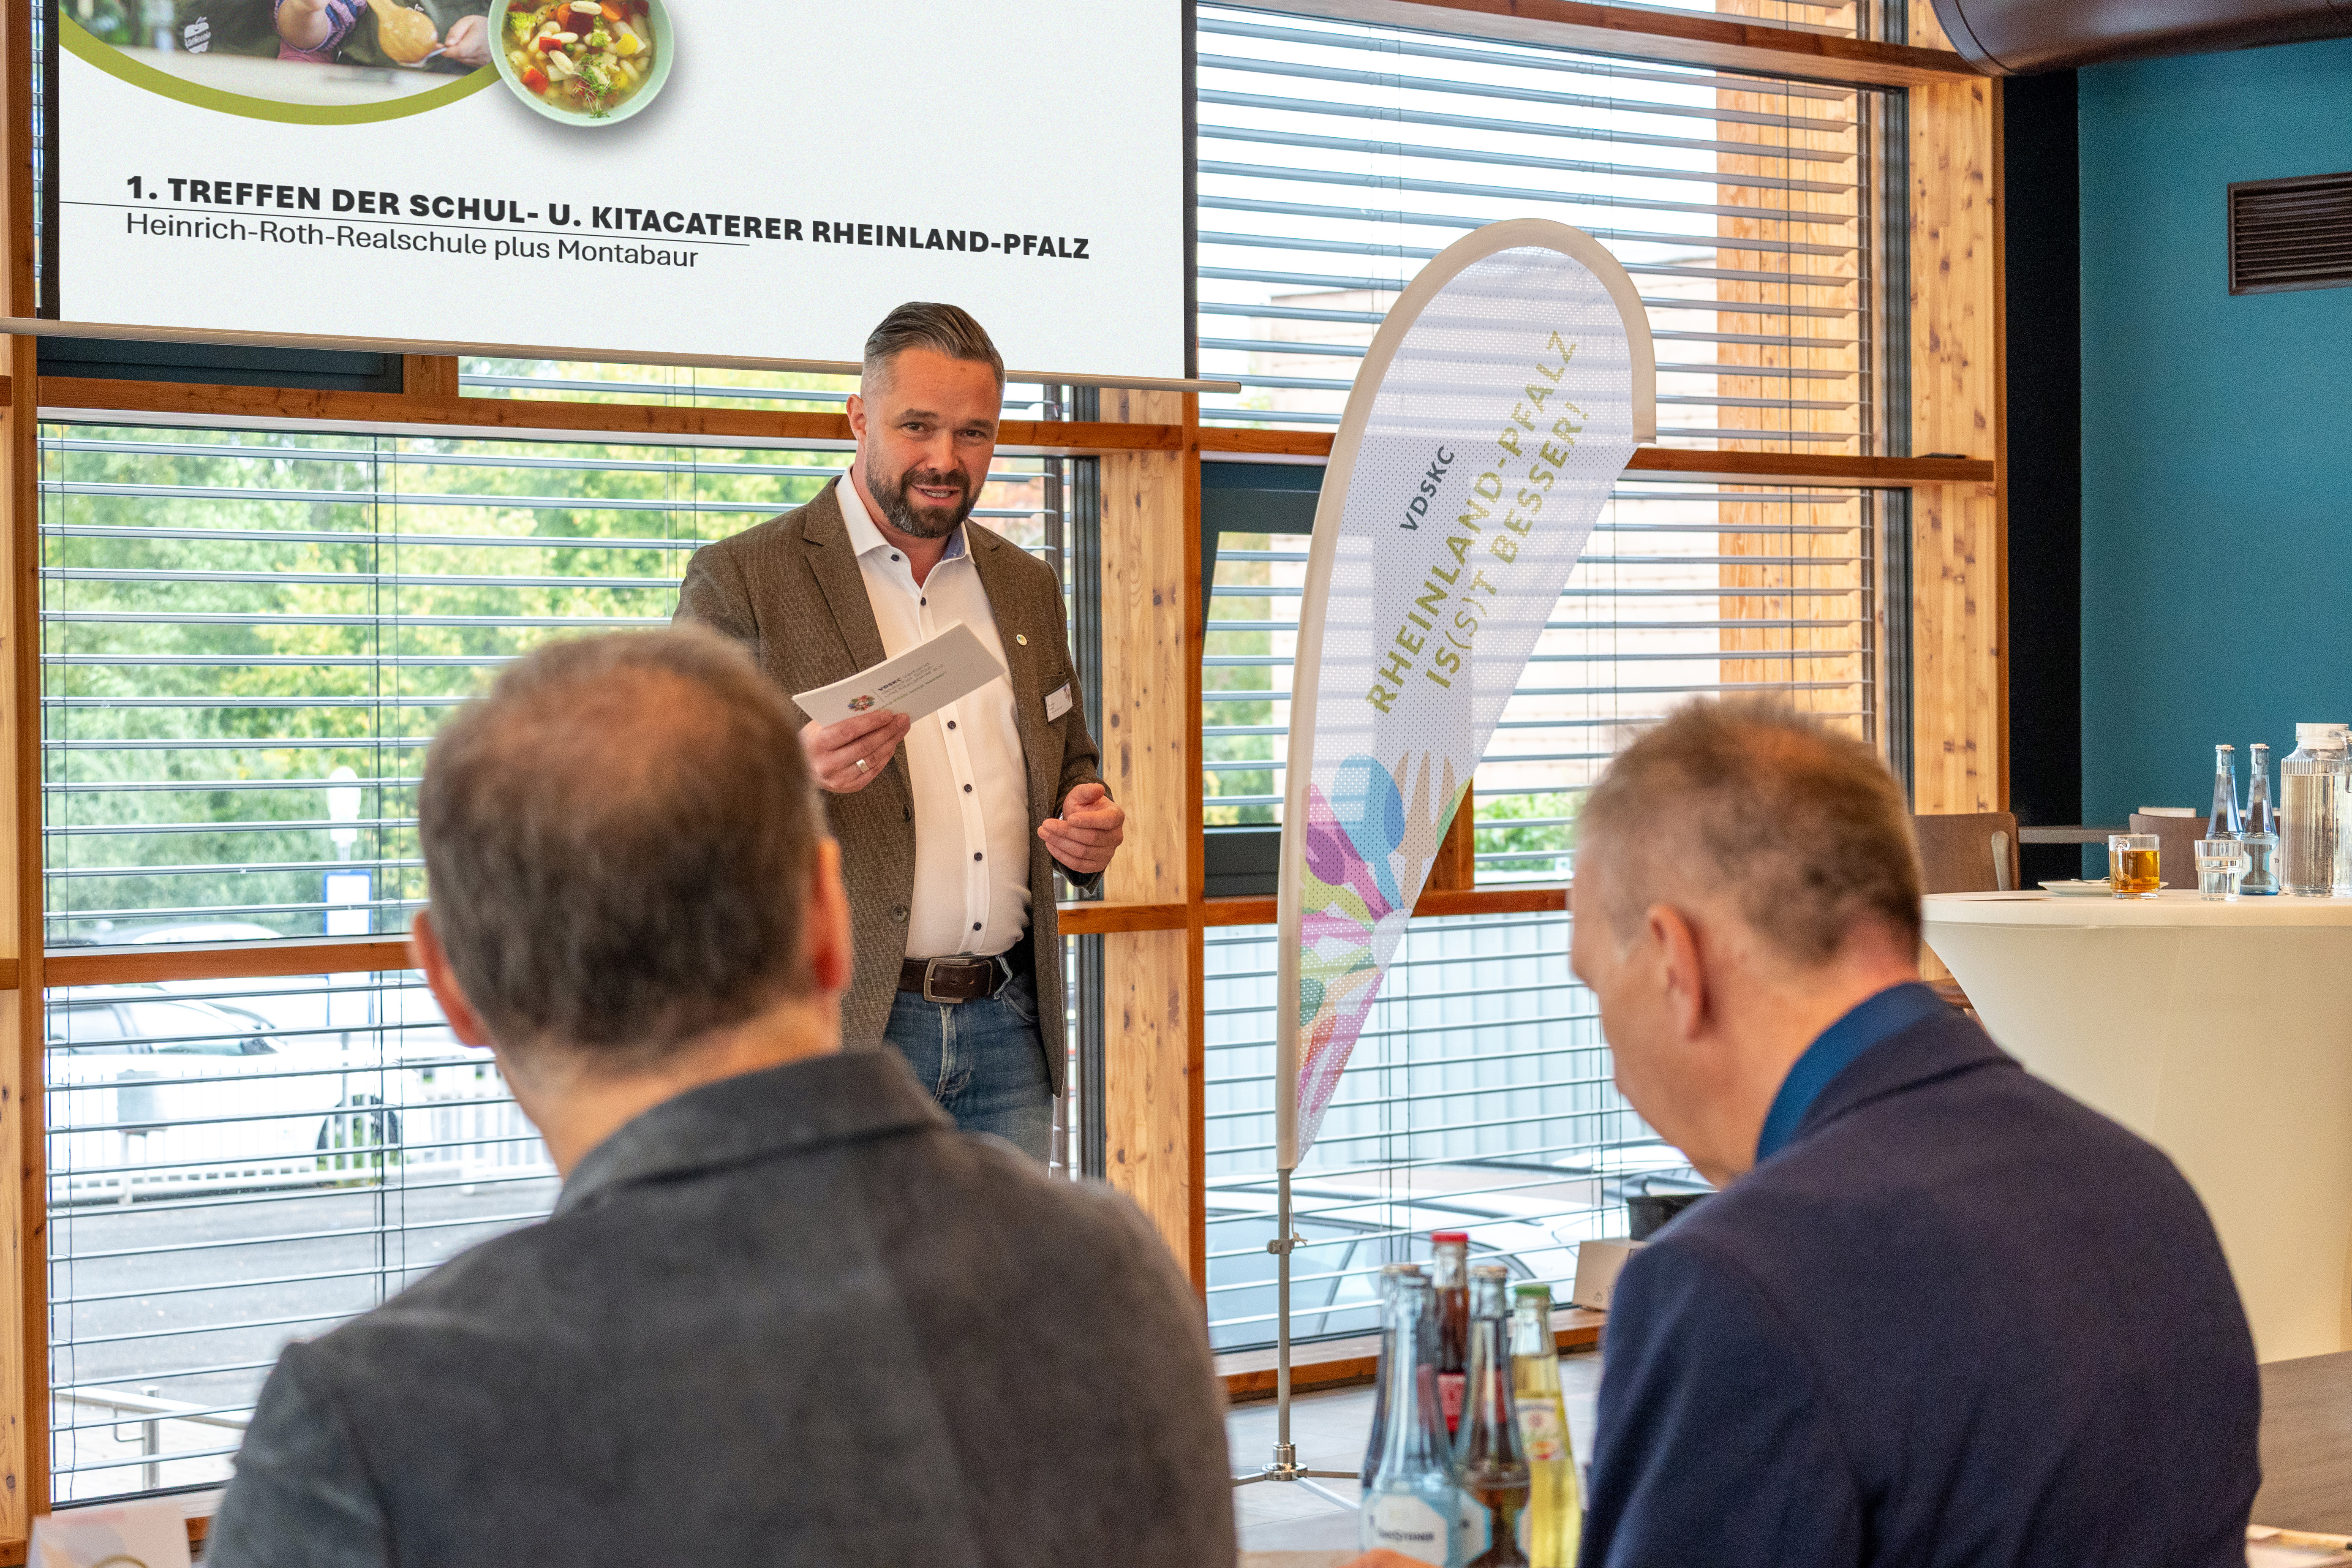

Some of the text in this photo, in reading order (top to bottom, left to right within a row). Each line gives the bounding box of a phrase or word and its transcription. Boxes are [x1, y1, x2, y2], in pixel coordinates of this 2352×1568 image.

[128, 176, 1089, 259] 1. TREFFEN DER SCHUL- U. KITACATERER RHEINLAND-PFALZ
[128, 212, 698, 267] Heinrich-Roth-Realschule plus Montabaur
[1366, 330, 1577, 714] RHEINLAND-PFALZ
[1399, 445, 1455, 530] VDSKC
[1426, 401, 1589, 689] IS(S)T BESSER!
